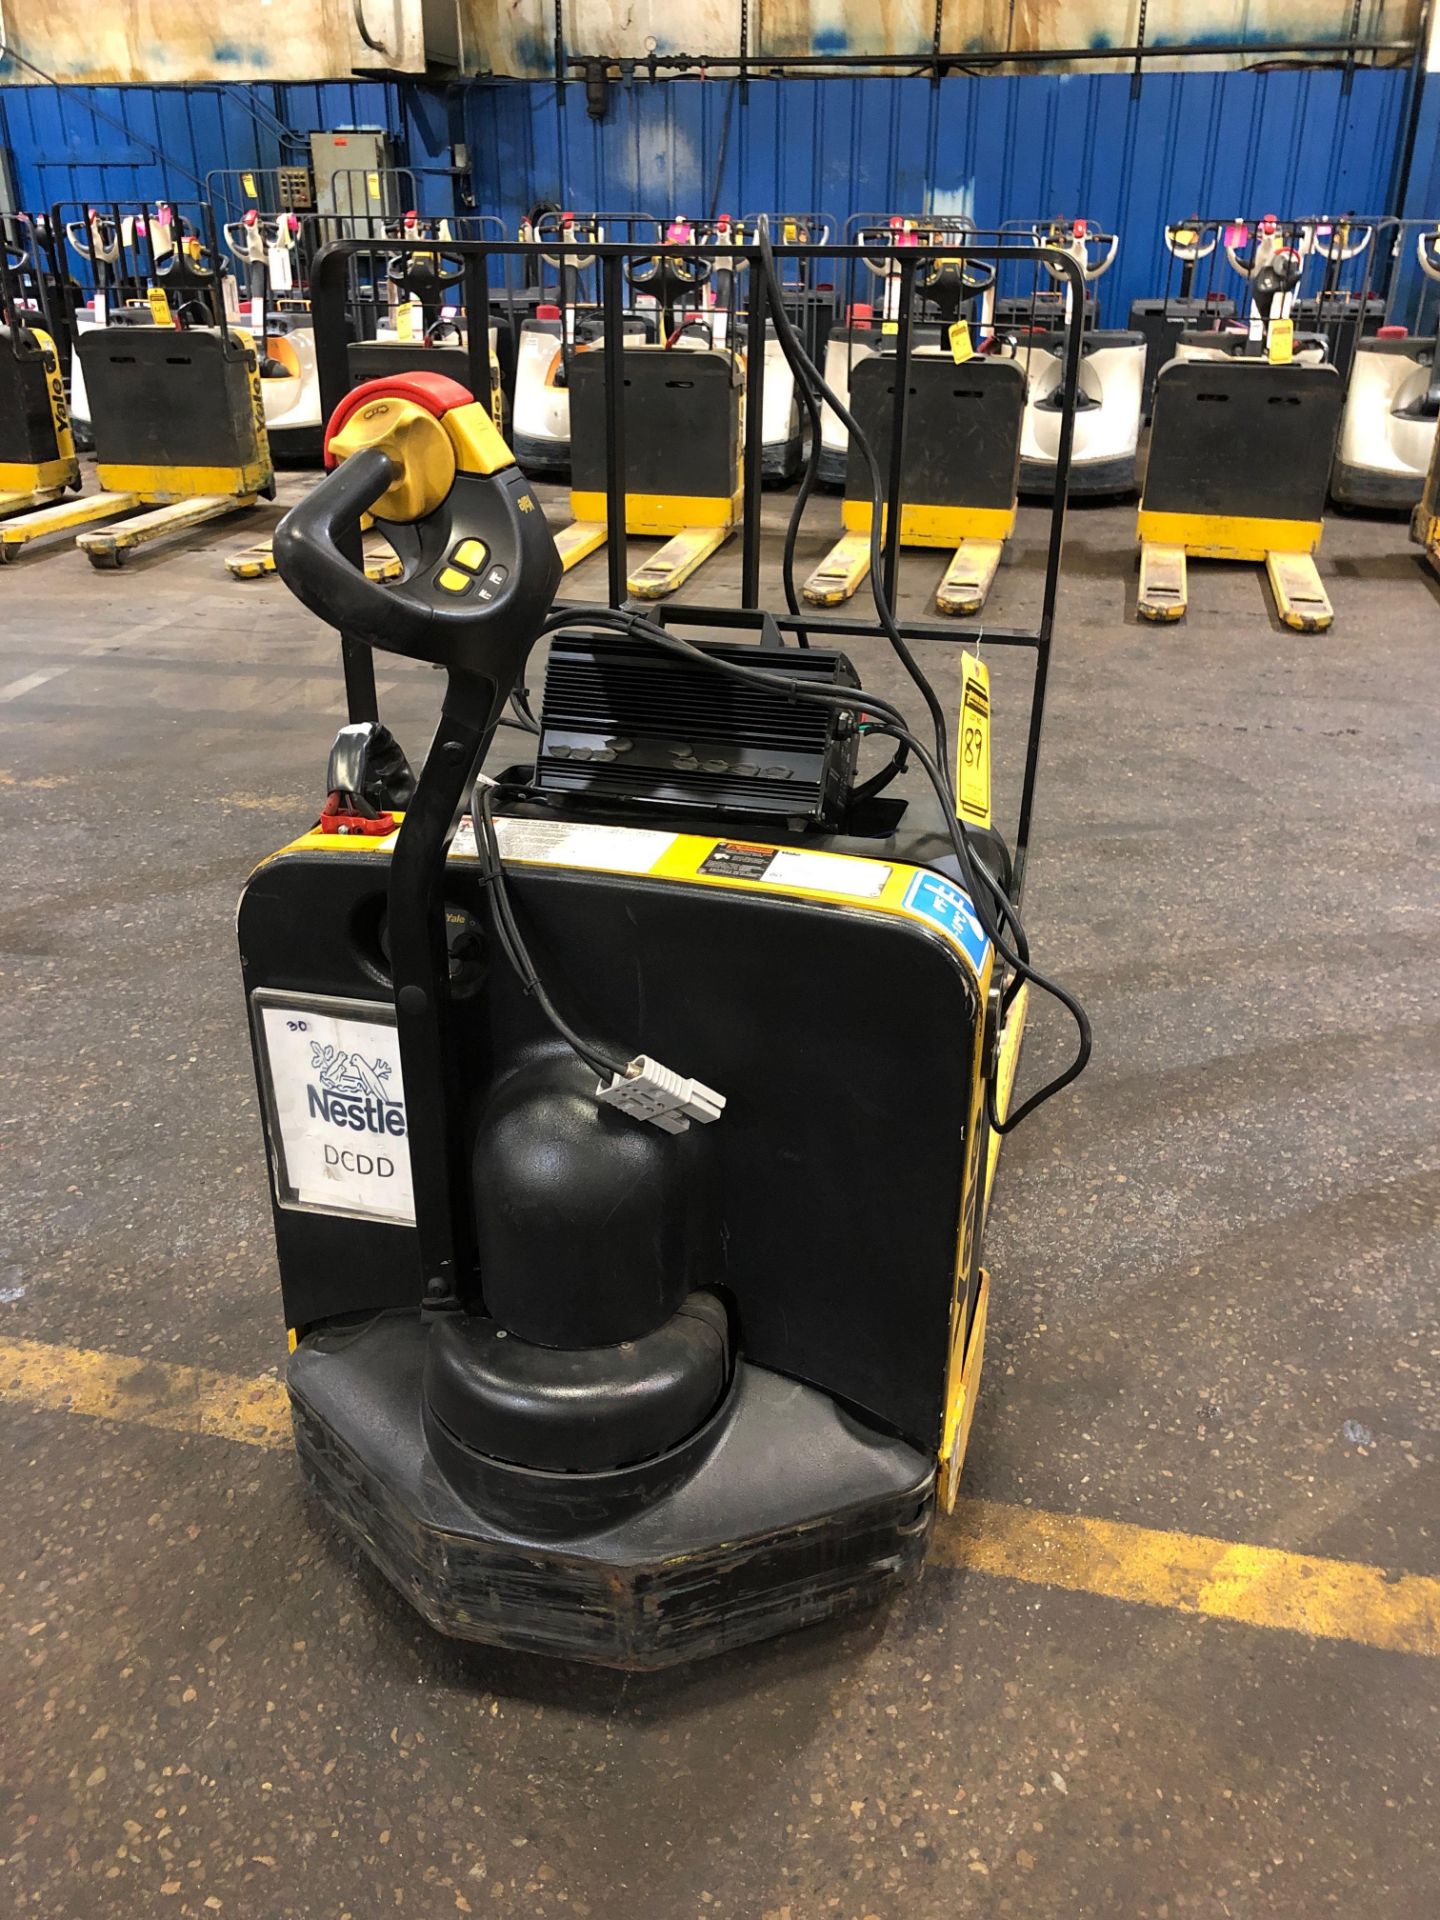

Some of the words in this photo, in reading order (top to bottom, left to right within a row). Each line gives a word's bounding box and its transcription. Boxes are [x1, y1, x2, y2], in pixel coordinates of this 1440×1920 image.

[52, 378, 69, 432] Yale
[252, 377, 265, 433] Yale
[963, 727, 983, 770] 89
[446, 913, 465, 924] Yale
[286, 1020, 308, 1032] 30
[324, 1144, 395, 1178] DCDD
